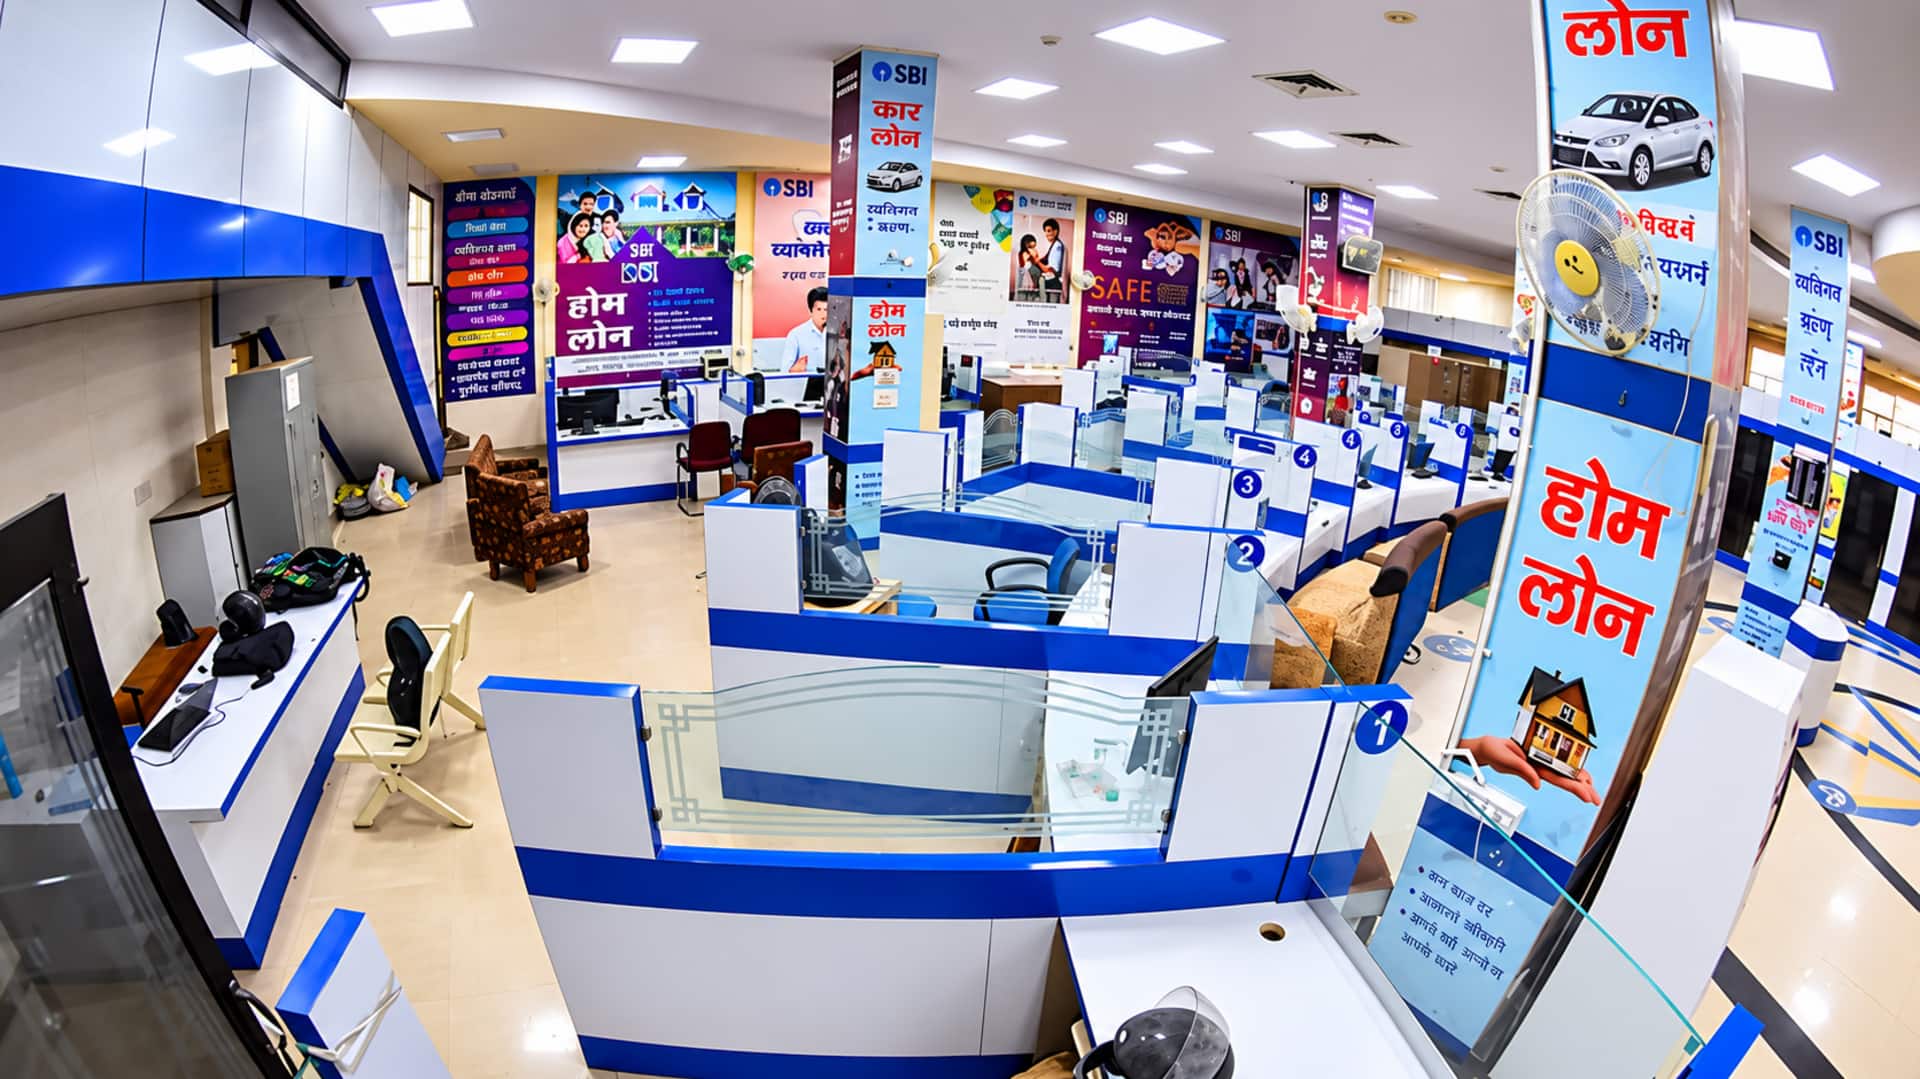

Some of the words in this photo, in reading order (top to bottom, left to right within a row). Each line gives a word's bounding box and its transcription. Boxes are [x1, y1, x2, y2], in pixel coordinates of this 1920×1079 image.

[1562, 0, 1690, 58] लोन
[894, 64, 927, 86] SBI
[872, 100, 923, 122] कार
[871, 123, 922, 148] लोन
[783, 179, 813, 198] SBI
[1108, 211, 1128, 226] SBI
[1224, 230, 1242, 243] SBI
[1814, 231, 1843, 258] SBI
[1091, 276, 1152, 303] SAFE
[567, 286, 628, 319] होम
[870, 300, 905, 318] होम
[567, 320, 634, 351] लोन
[868, 318, 906, 337] लोन
[1298, 449, 1311, 466] 4
[1240, 475, 1255, 495] 3
[1539, 456, 1671, 560] होम
[1237, 542, 1255, 566] 2
[1517, 555, 1654, 657] लोन
[1374, 710, 1393, 746] 1
